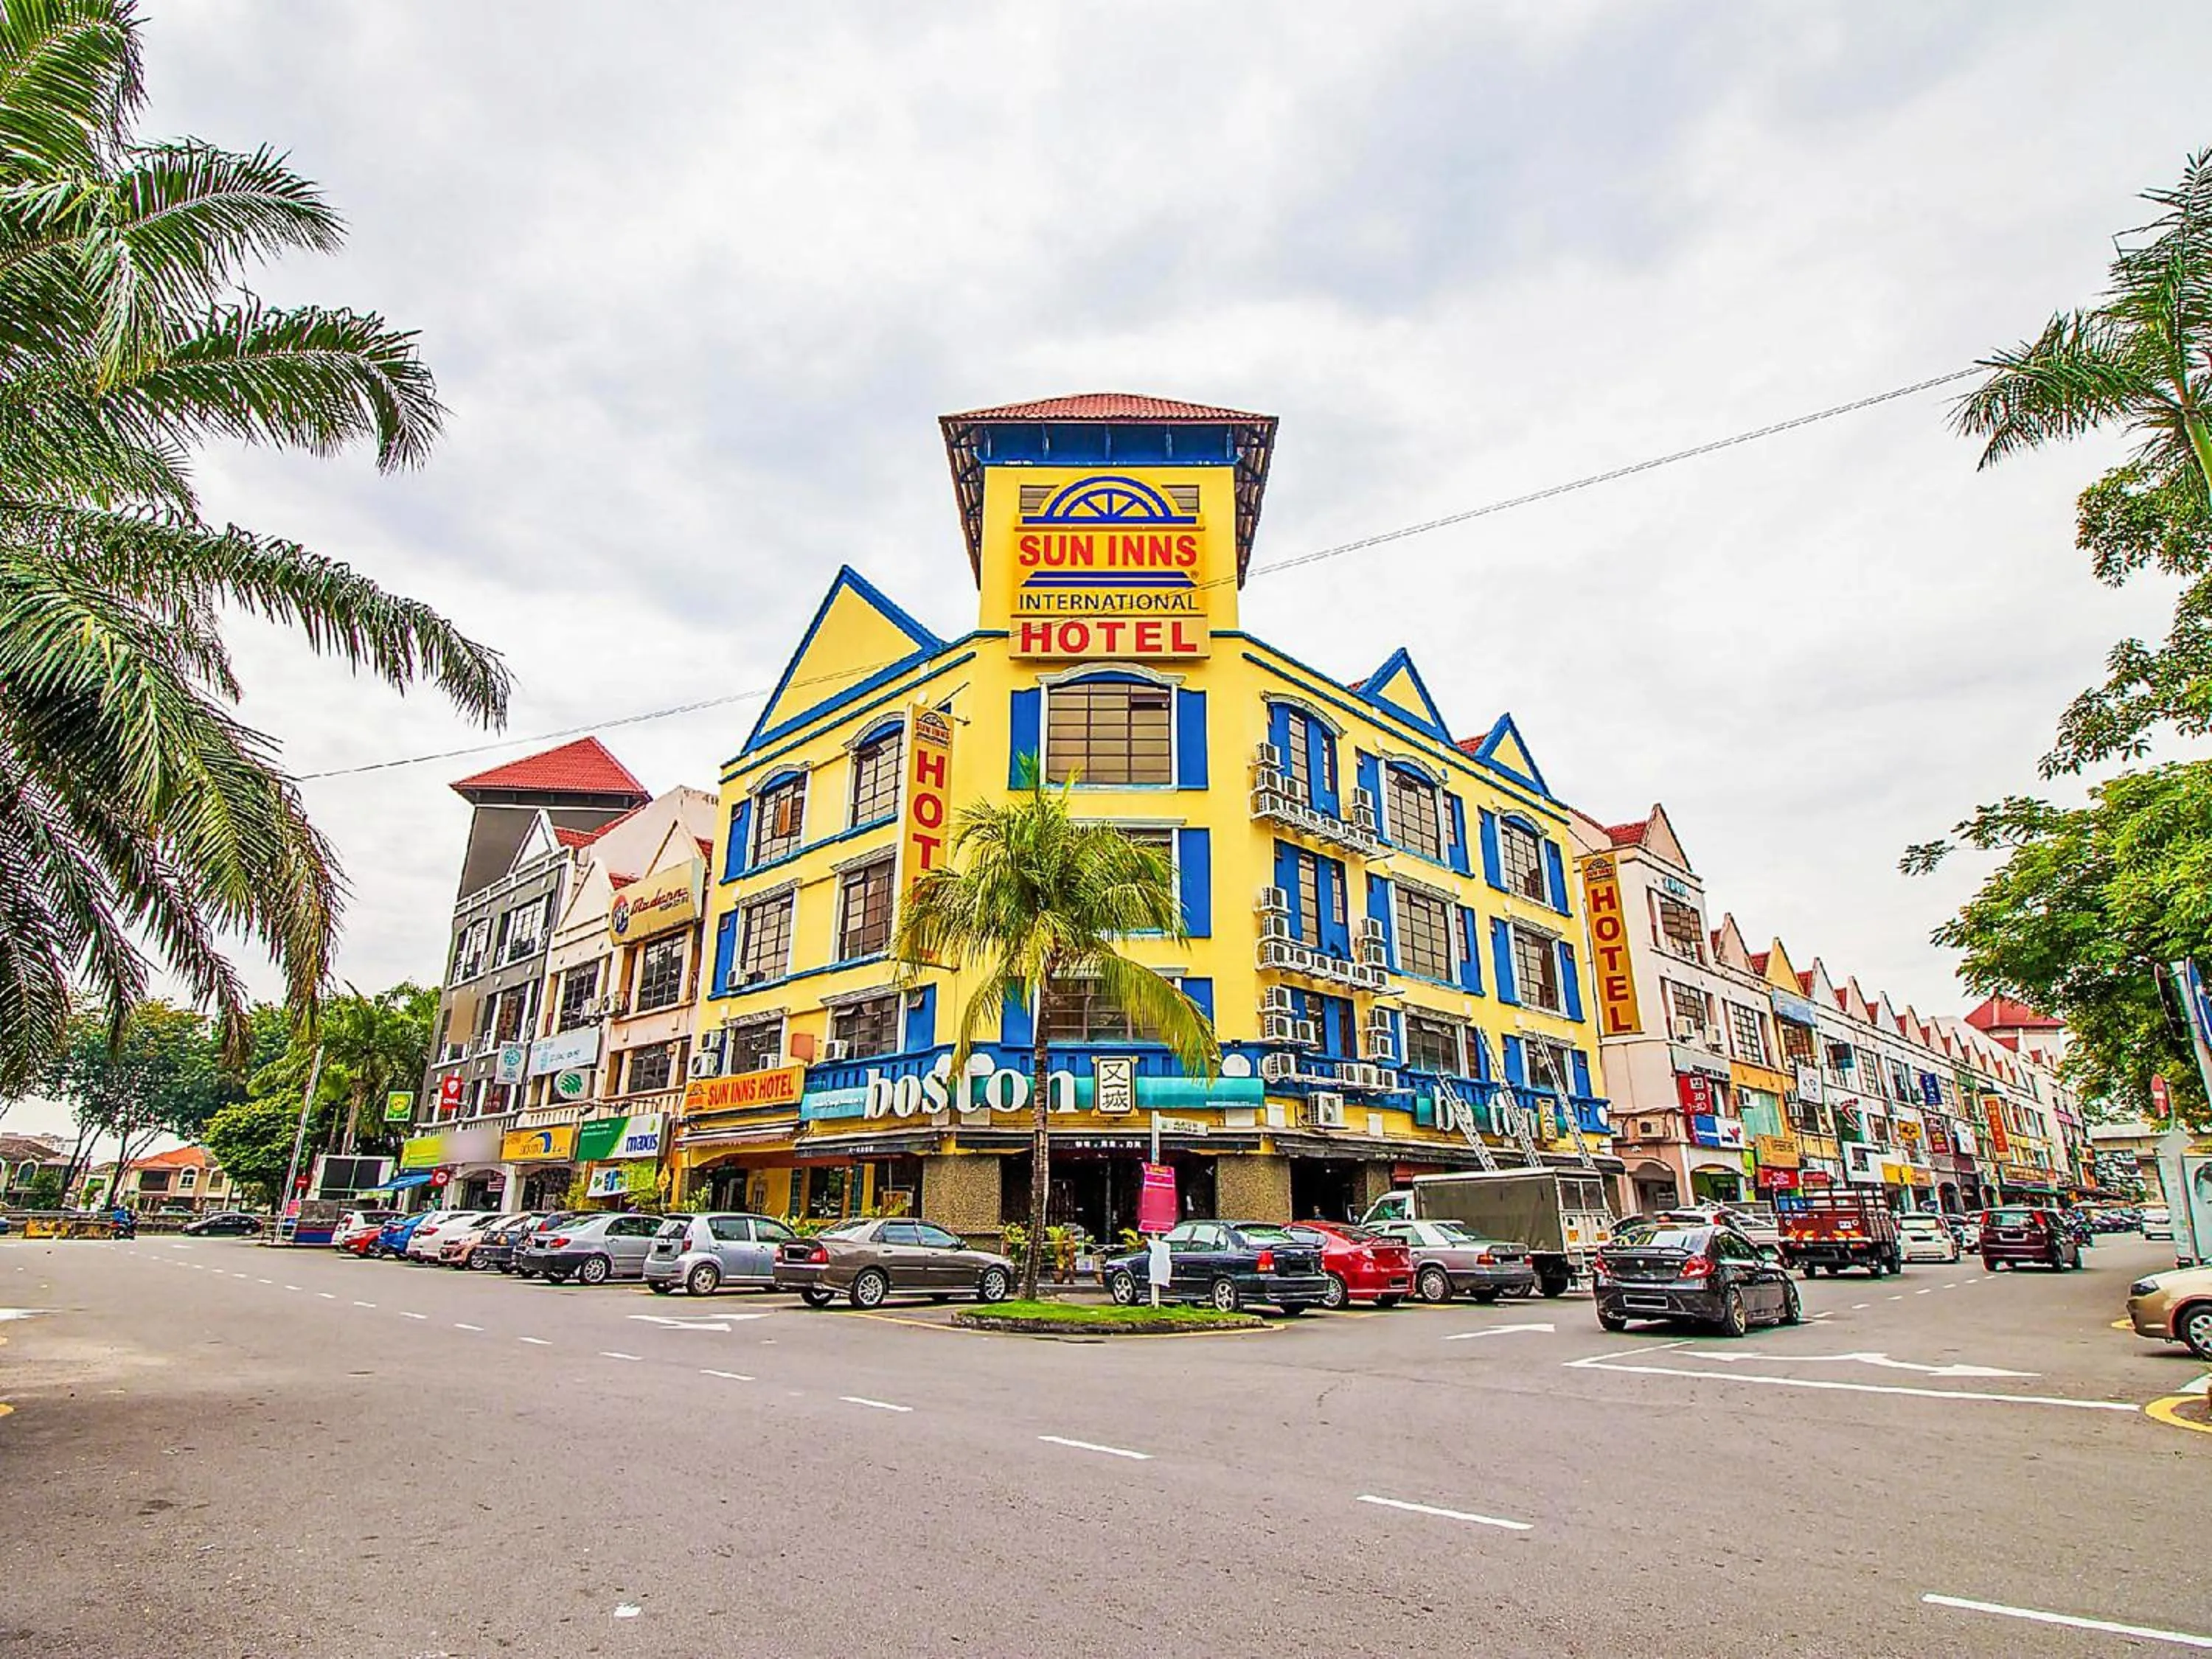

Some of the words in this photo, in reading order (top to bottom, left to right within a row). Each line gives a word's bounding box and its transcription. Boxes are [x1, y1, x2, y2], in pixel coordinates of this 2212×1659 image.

[1019, 535, 1093, 567] SUN
[1108, 535, 1197, 567] INNS
[1019, 594, 1199, 611] INTERNATIONAL
[1020, 622, 1197, 653] HOTEL
[911, 749, 946, 958] HOT
[1590, 886, 1632, 1032] HOTEL
[708, 1082, 729, 1106] SUN
[731, 1078, 757, 1103] INNS
[759, 1073, 793, 1101] HOTEL
[1102, 1062, 1128, 1108] 又一城
[626, 1134, 658, 1152] maxis
